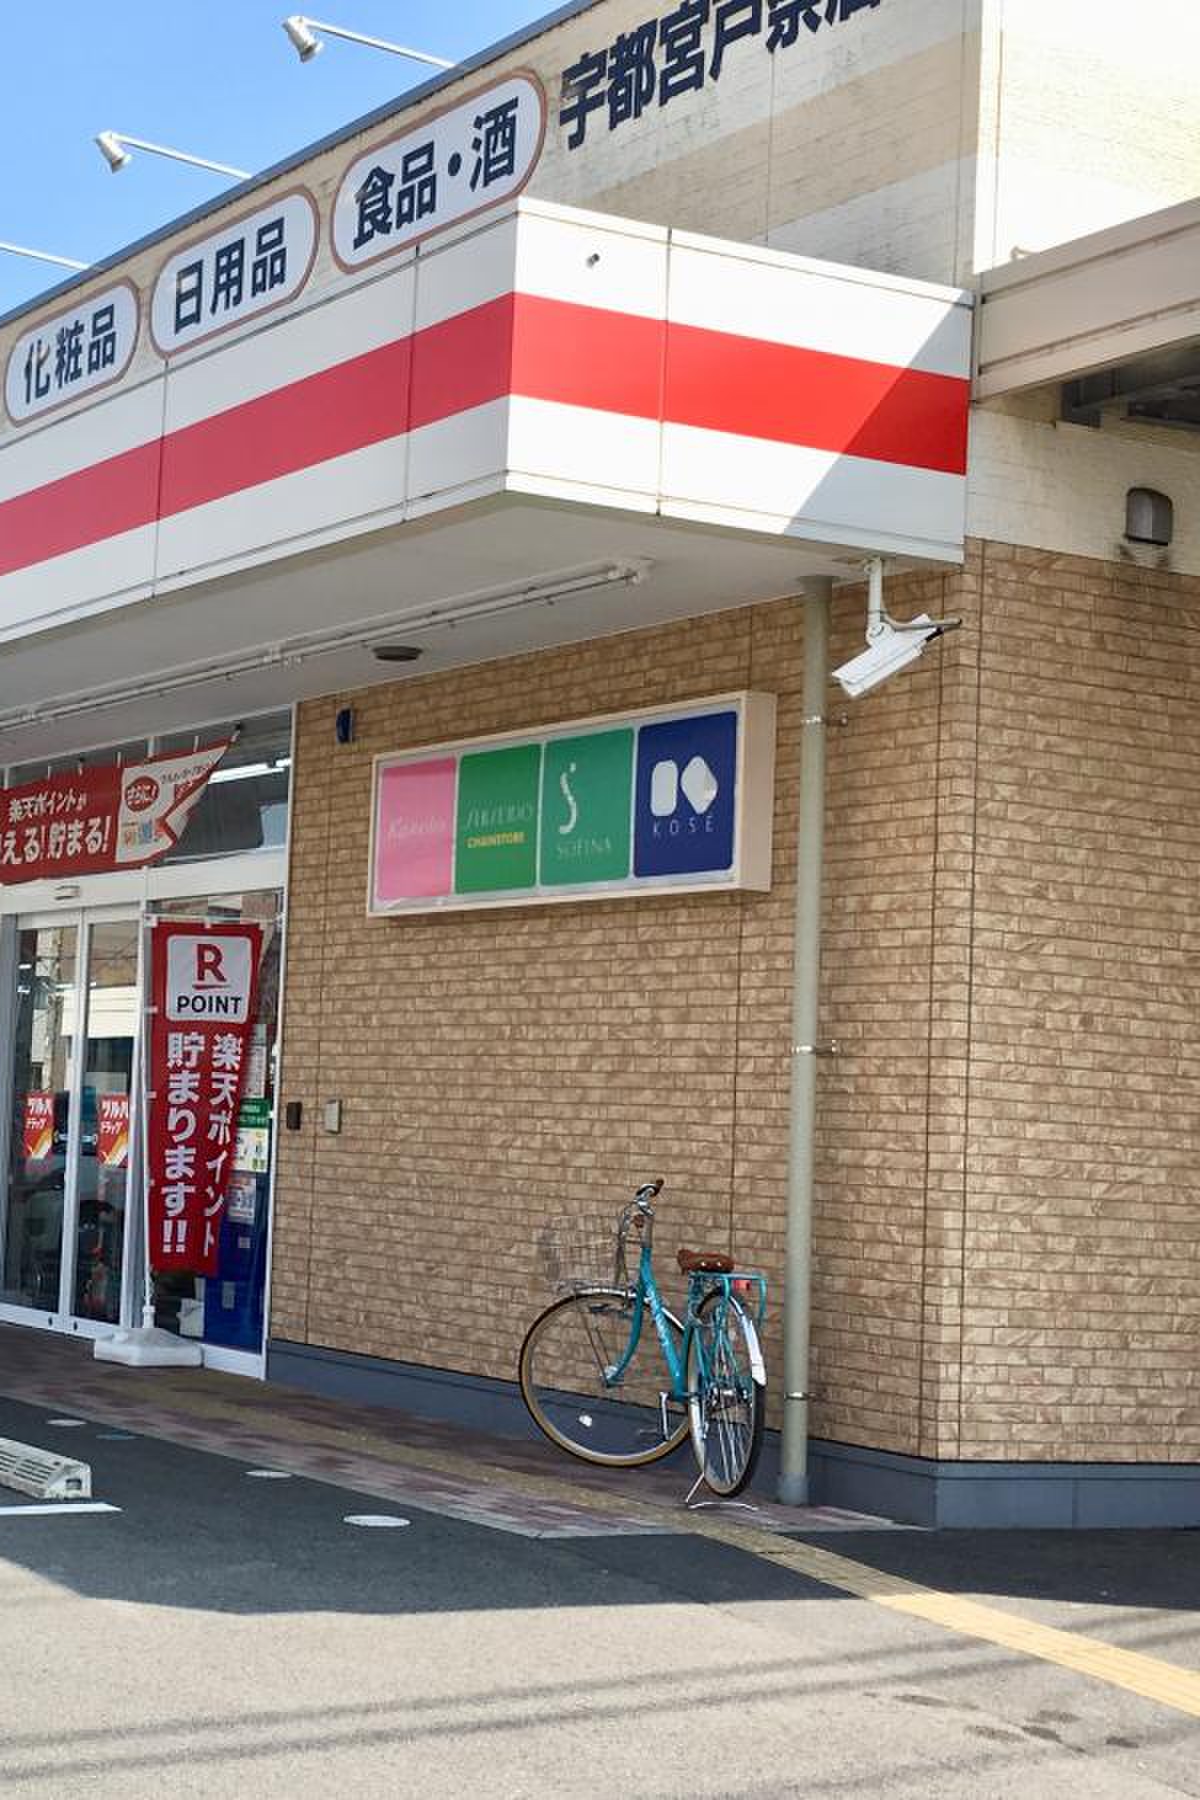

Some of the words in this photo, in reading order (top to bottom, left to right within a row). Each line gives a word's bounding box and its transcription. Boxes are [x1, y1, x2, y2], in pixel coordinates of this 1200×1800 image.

[559, 0, 880, 150] 宇都宮戸
[354, 97, 519, 250] 食品・酒
[175, 217, 287, 335] 日用品
[24, 304, 116, 404] 化粧品
[176, 995, 242, 1015] POINT
[196, 943, 228, 984] R
[202, 1032, 243, 1257] 楽天ポイント
